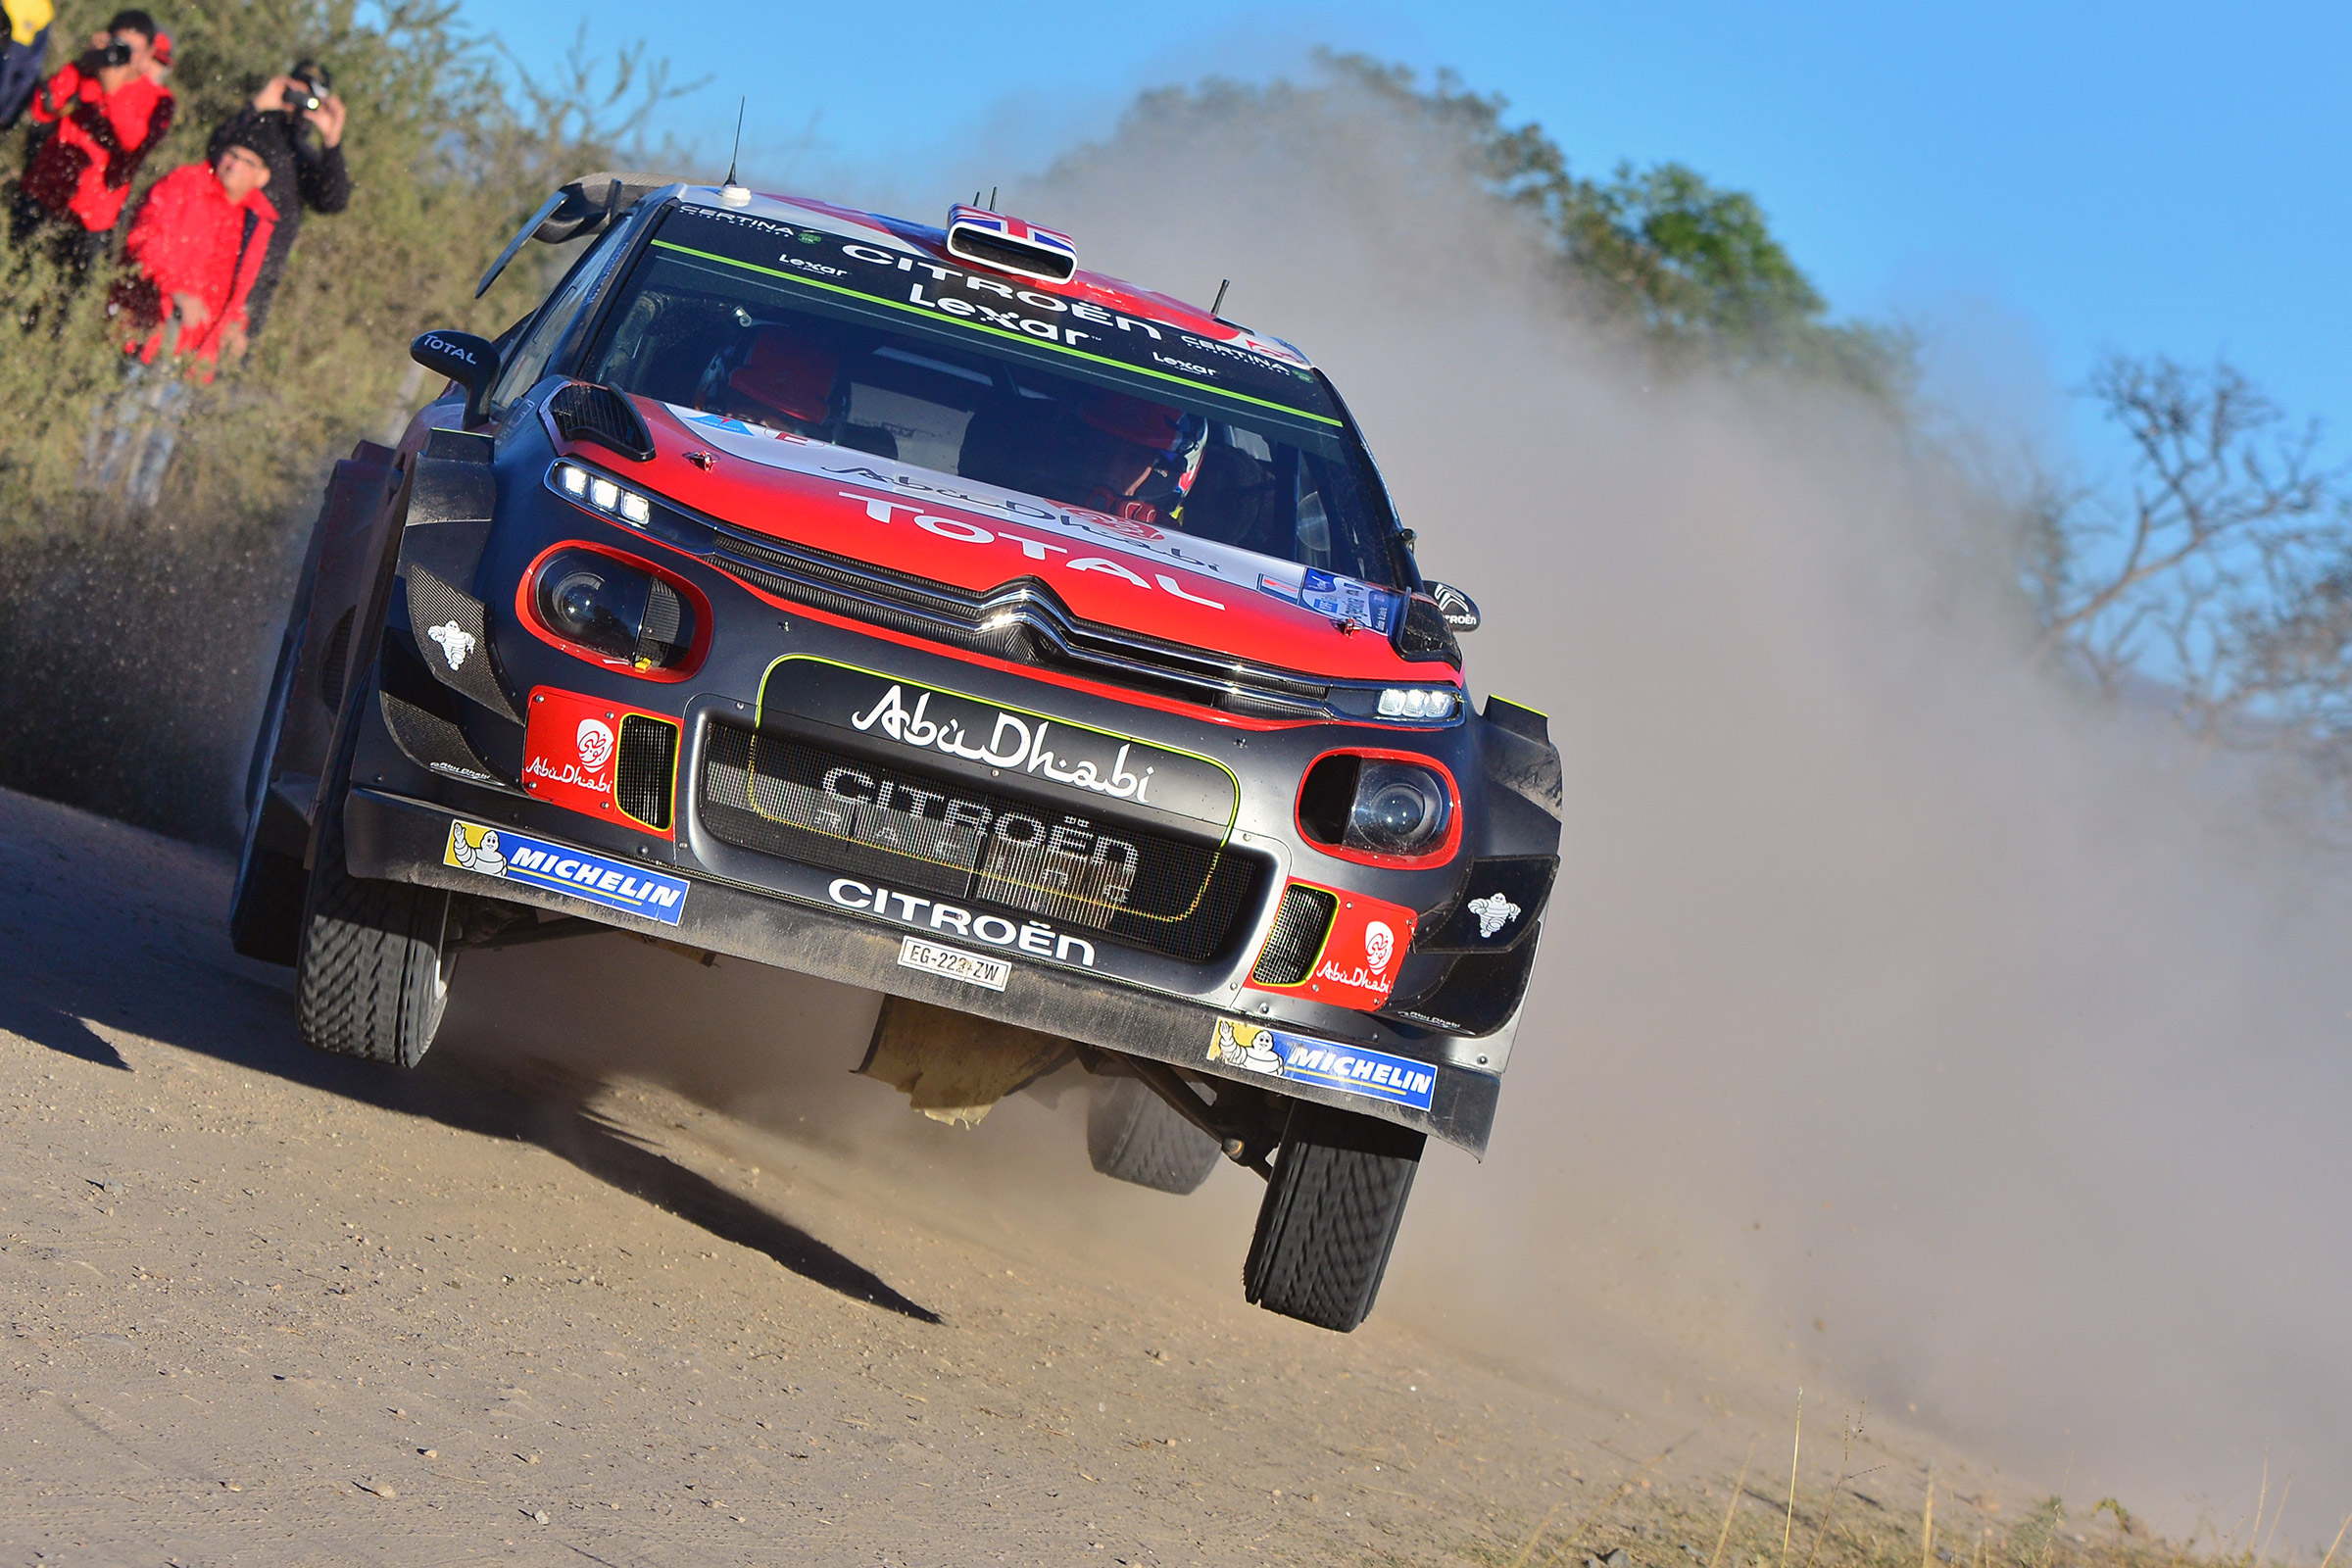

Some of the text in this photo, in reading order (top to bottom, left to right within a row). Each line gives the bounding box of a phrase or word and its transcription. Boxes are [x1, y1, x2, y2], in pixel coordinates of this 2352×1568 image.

[680, 205, 795, 236] CERTINA
[779, 254, 847, 277] Lexar
[909, 283, 1090, 346] Lexar
[423, 334, 478, 366] TOTAL
[1152, 351, 1217, 376] Lexar
[1181, 335, 1290, 375] CERTINA
[838, 491, 1226, 611] TOTAL
[1445, 612, 1477, 625] ROËN
[509, 846, 682, 909] MICHELIN
[828, 877, 1097, 967] CITROËN
[1285, 1046, 1433, 1095] MICHELIN
